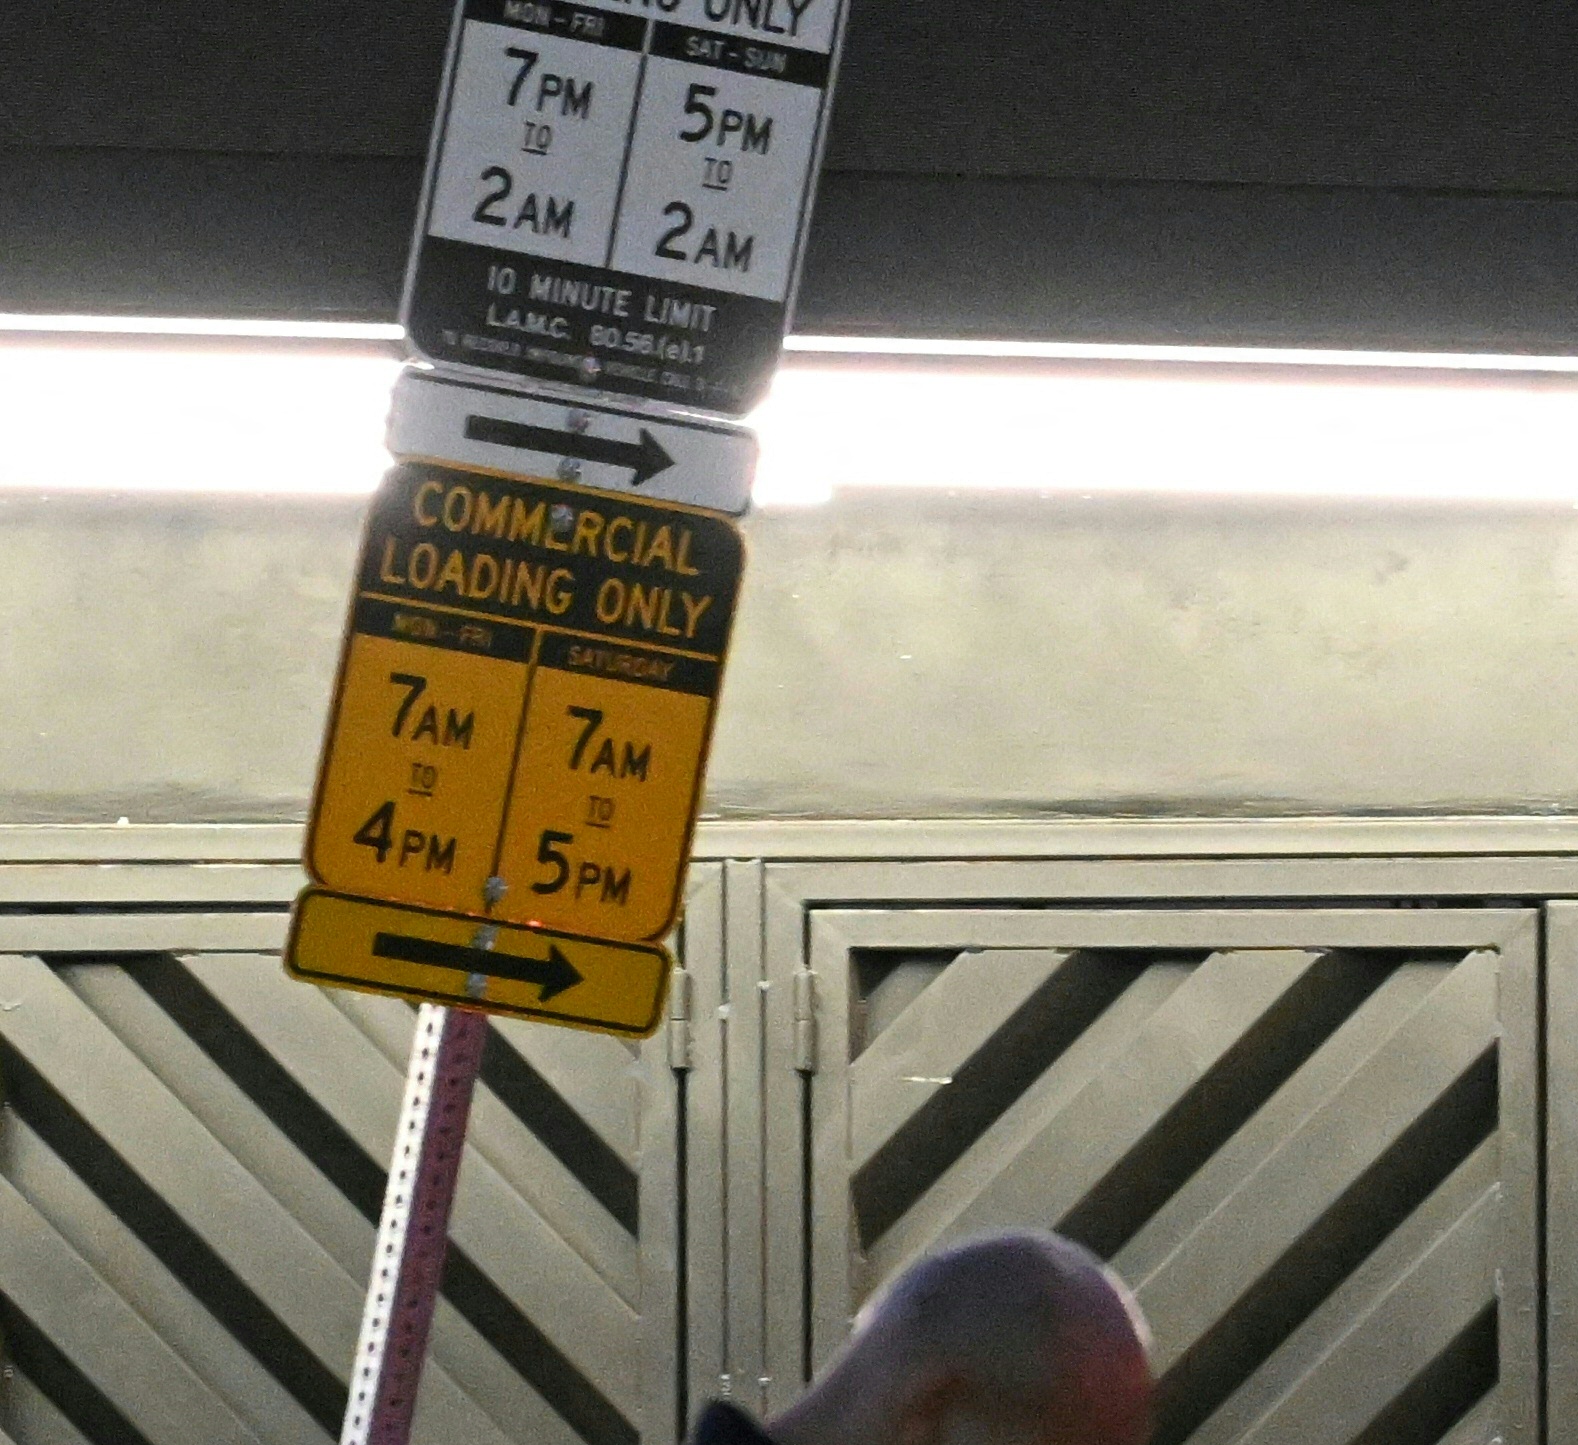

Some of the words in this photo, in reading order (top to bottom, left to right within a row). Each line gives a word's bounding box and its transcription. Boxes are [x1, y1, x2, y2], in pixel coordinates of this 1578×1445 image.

[487, 265, 517, 295] 10
[529, 274, 632, 318] MINUTE
[643, 294, 717, 333] LIMIT
[380, 537, 576, 615] LOADING
[596, 577, 713, 639] ONLY
